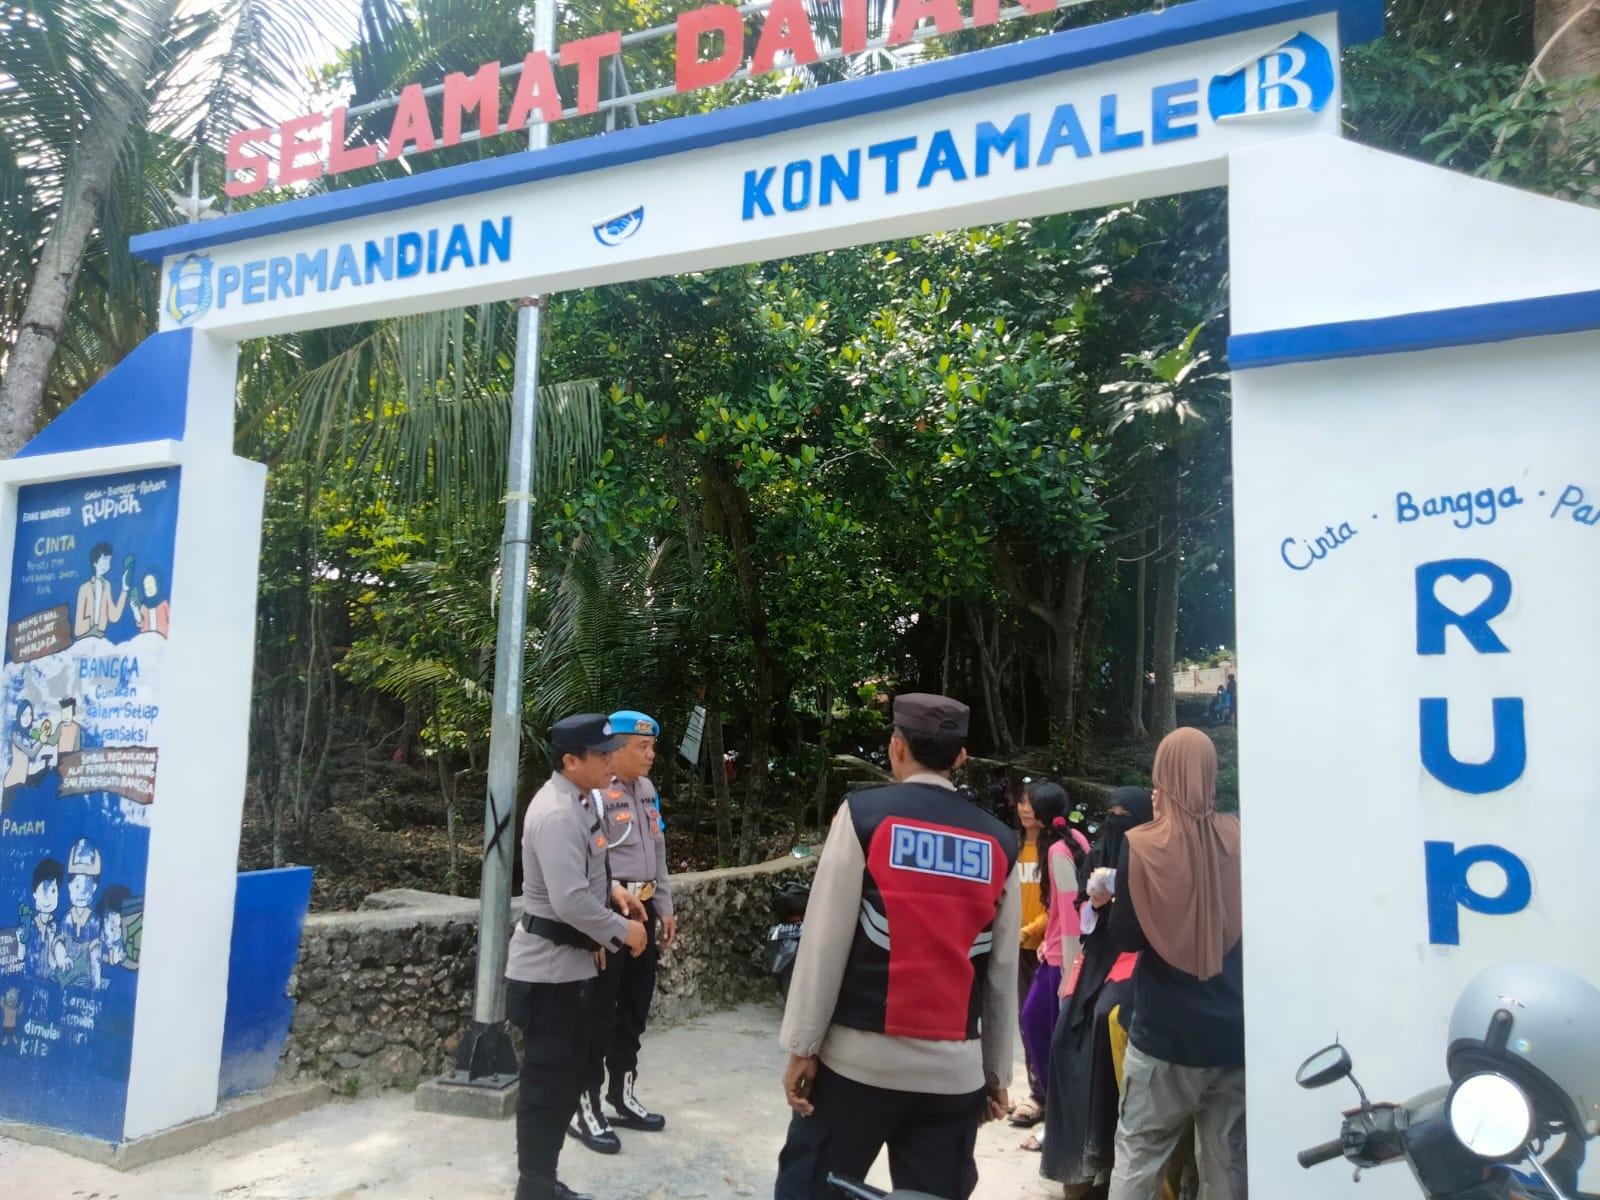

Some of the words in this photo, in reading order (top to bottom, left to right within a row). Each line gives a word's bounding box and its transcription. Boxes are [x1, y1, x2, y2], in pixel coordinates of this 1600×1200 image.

[223, 31, 622, 198] SELAMAT
[217, 215, 513, 309] PERMANDIAN
[741, 78, 1199, 221] KONTAMALE
[34, 534, 76, 556] CINTA
[1281, 521, 1358, 571] Cinta
[1396, 485, 1524, 529] Bangga
[79, 656, 139, 679] BANGGA
[2, 818, 46, 837] PAHAM
[894, 829, 990, 880] POLISI
